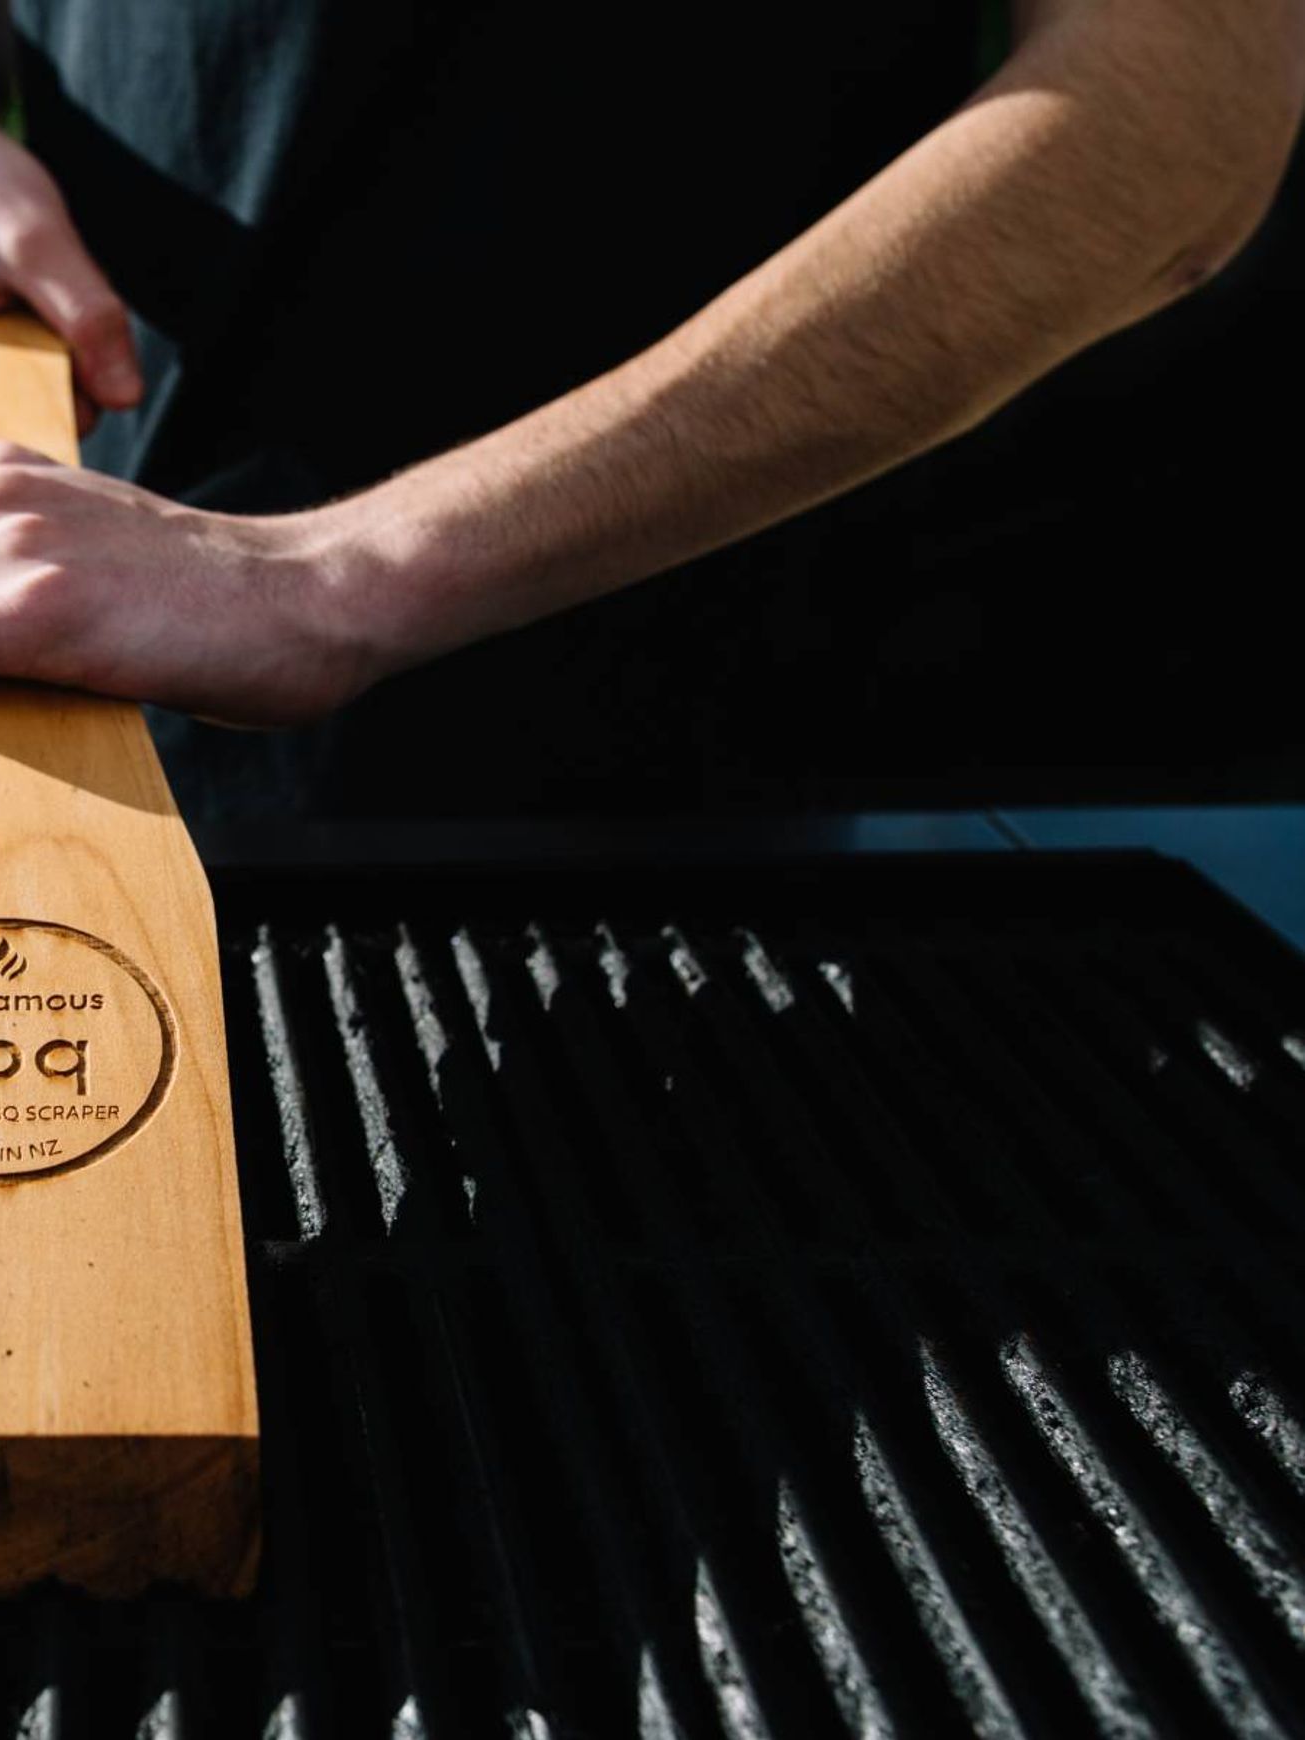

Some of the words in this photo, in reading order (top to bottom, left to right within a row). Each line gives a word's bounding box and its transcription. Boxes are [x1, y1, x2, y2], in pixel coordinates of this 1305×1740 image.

[26, 1105, 120, 1121] SCRAPER
[0, 1145, 22, 1162] IN
[29, 1139, 63, 1159] NZ
